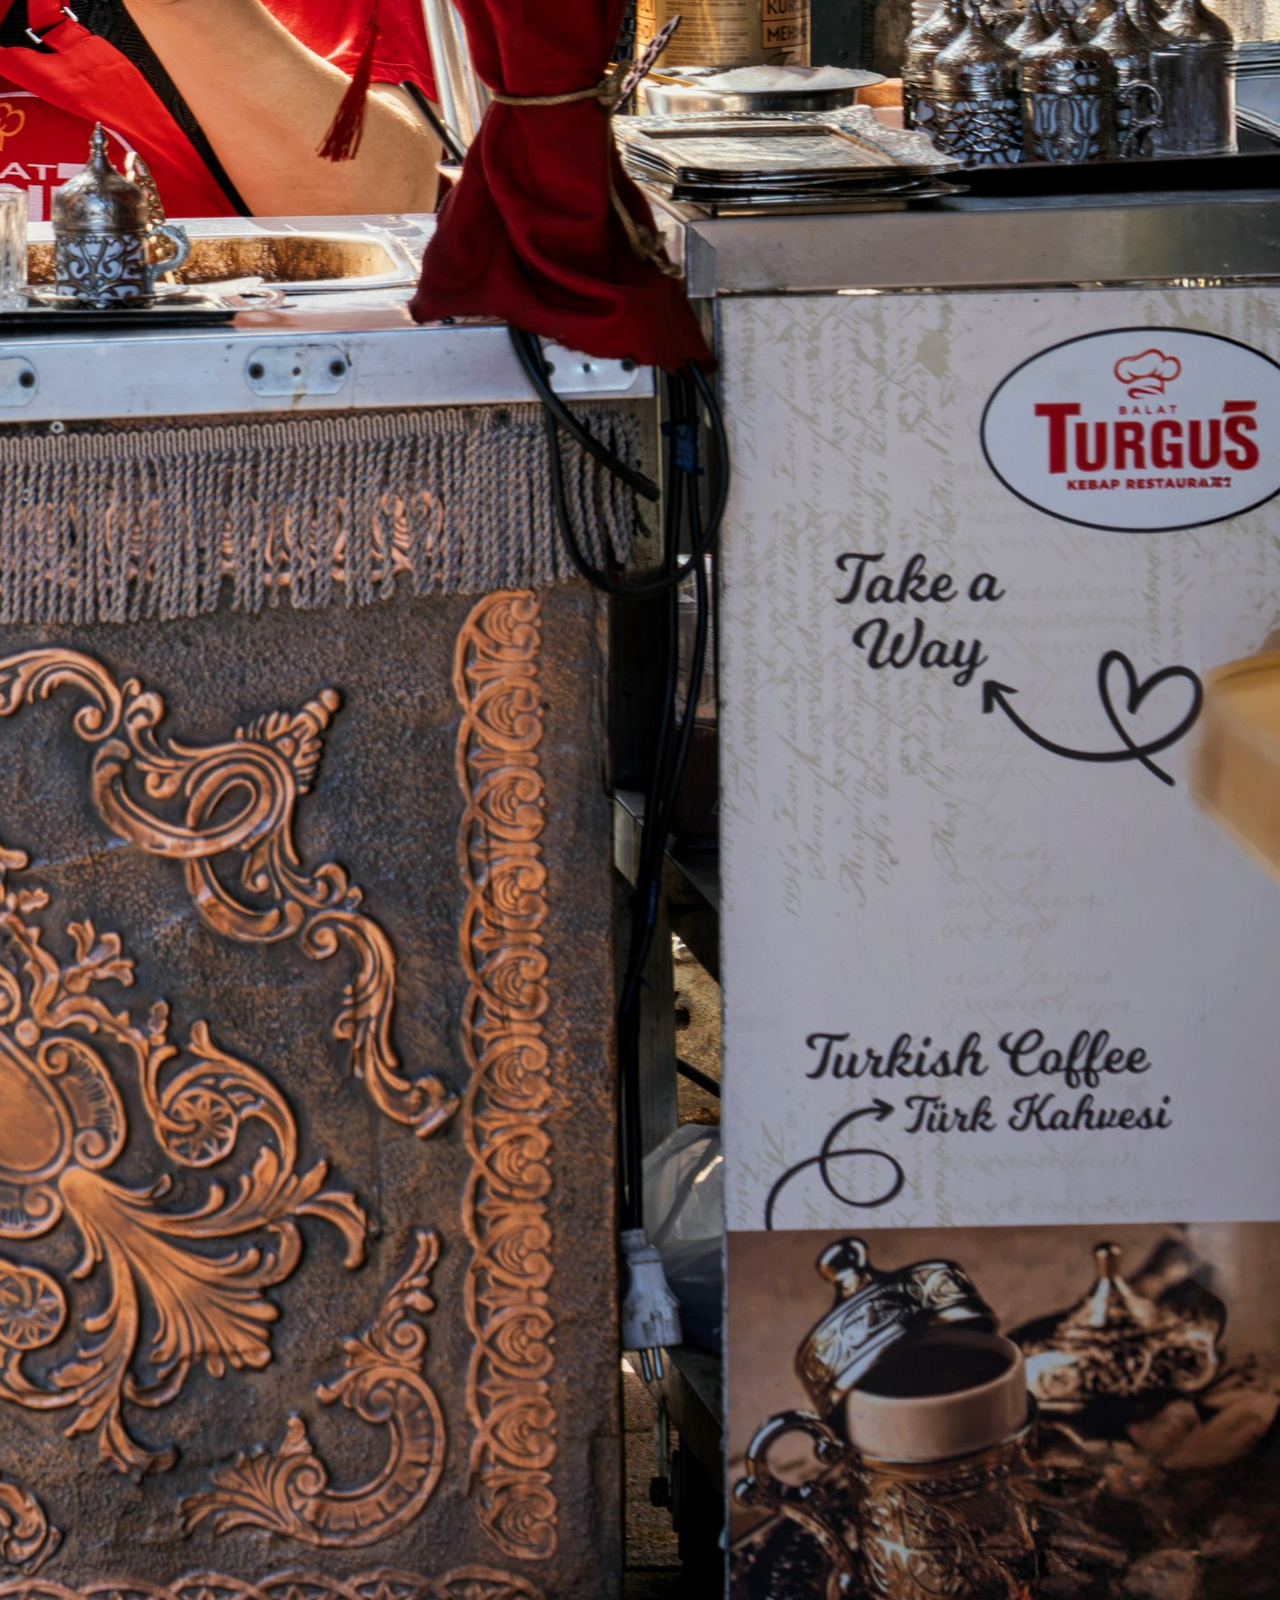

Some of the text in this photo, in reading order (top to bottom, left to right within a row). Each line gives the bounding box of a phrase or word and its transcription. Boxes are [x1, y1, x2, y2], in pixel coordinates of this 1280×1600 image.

[1118, 404, 1178, 416] BALAT
[1066, 478, 1120, 491] KEBAP
[834, 552, 1006, 605] Take a
[852, 616, 989, 687] Way
[805, 1028, 1152, 1089] Turkish Coffee
[904, 1092, 1173, 1133] Türk Kahvesi
